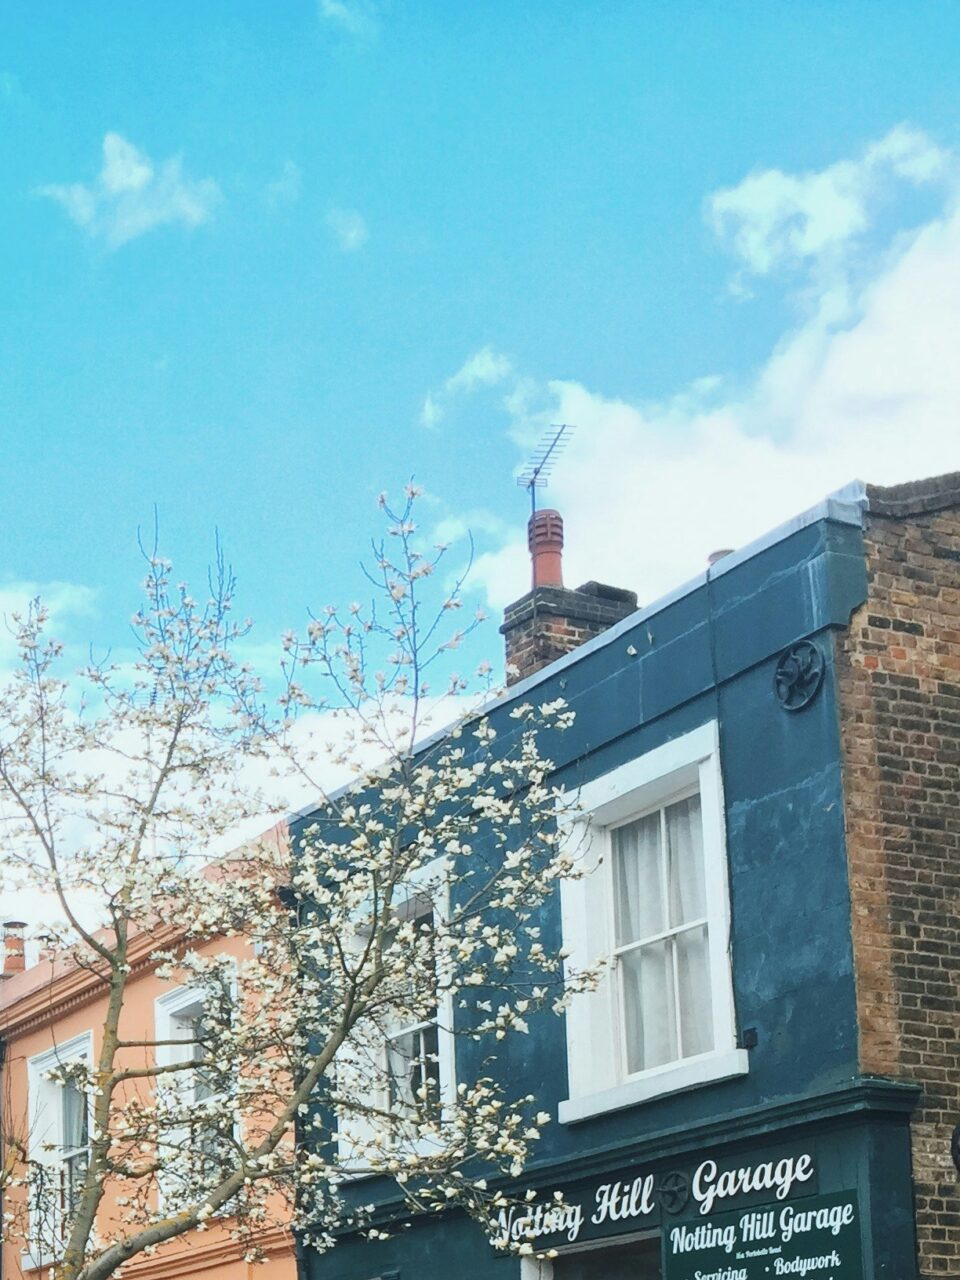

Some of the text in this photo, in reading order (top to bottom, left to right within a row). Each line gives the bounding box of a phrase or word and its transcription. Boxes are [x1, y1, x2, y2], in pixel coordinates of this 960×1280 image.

[591, 1174, 655, 1224] Hill
[692, 1154, 814, 1214] Garage
[670, 1204, 854, 1254] Notting Hill Garage
[774, 1250, 841, 1277] Bodywork
